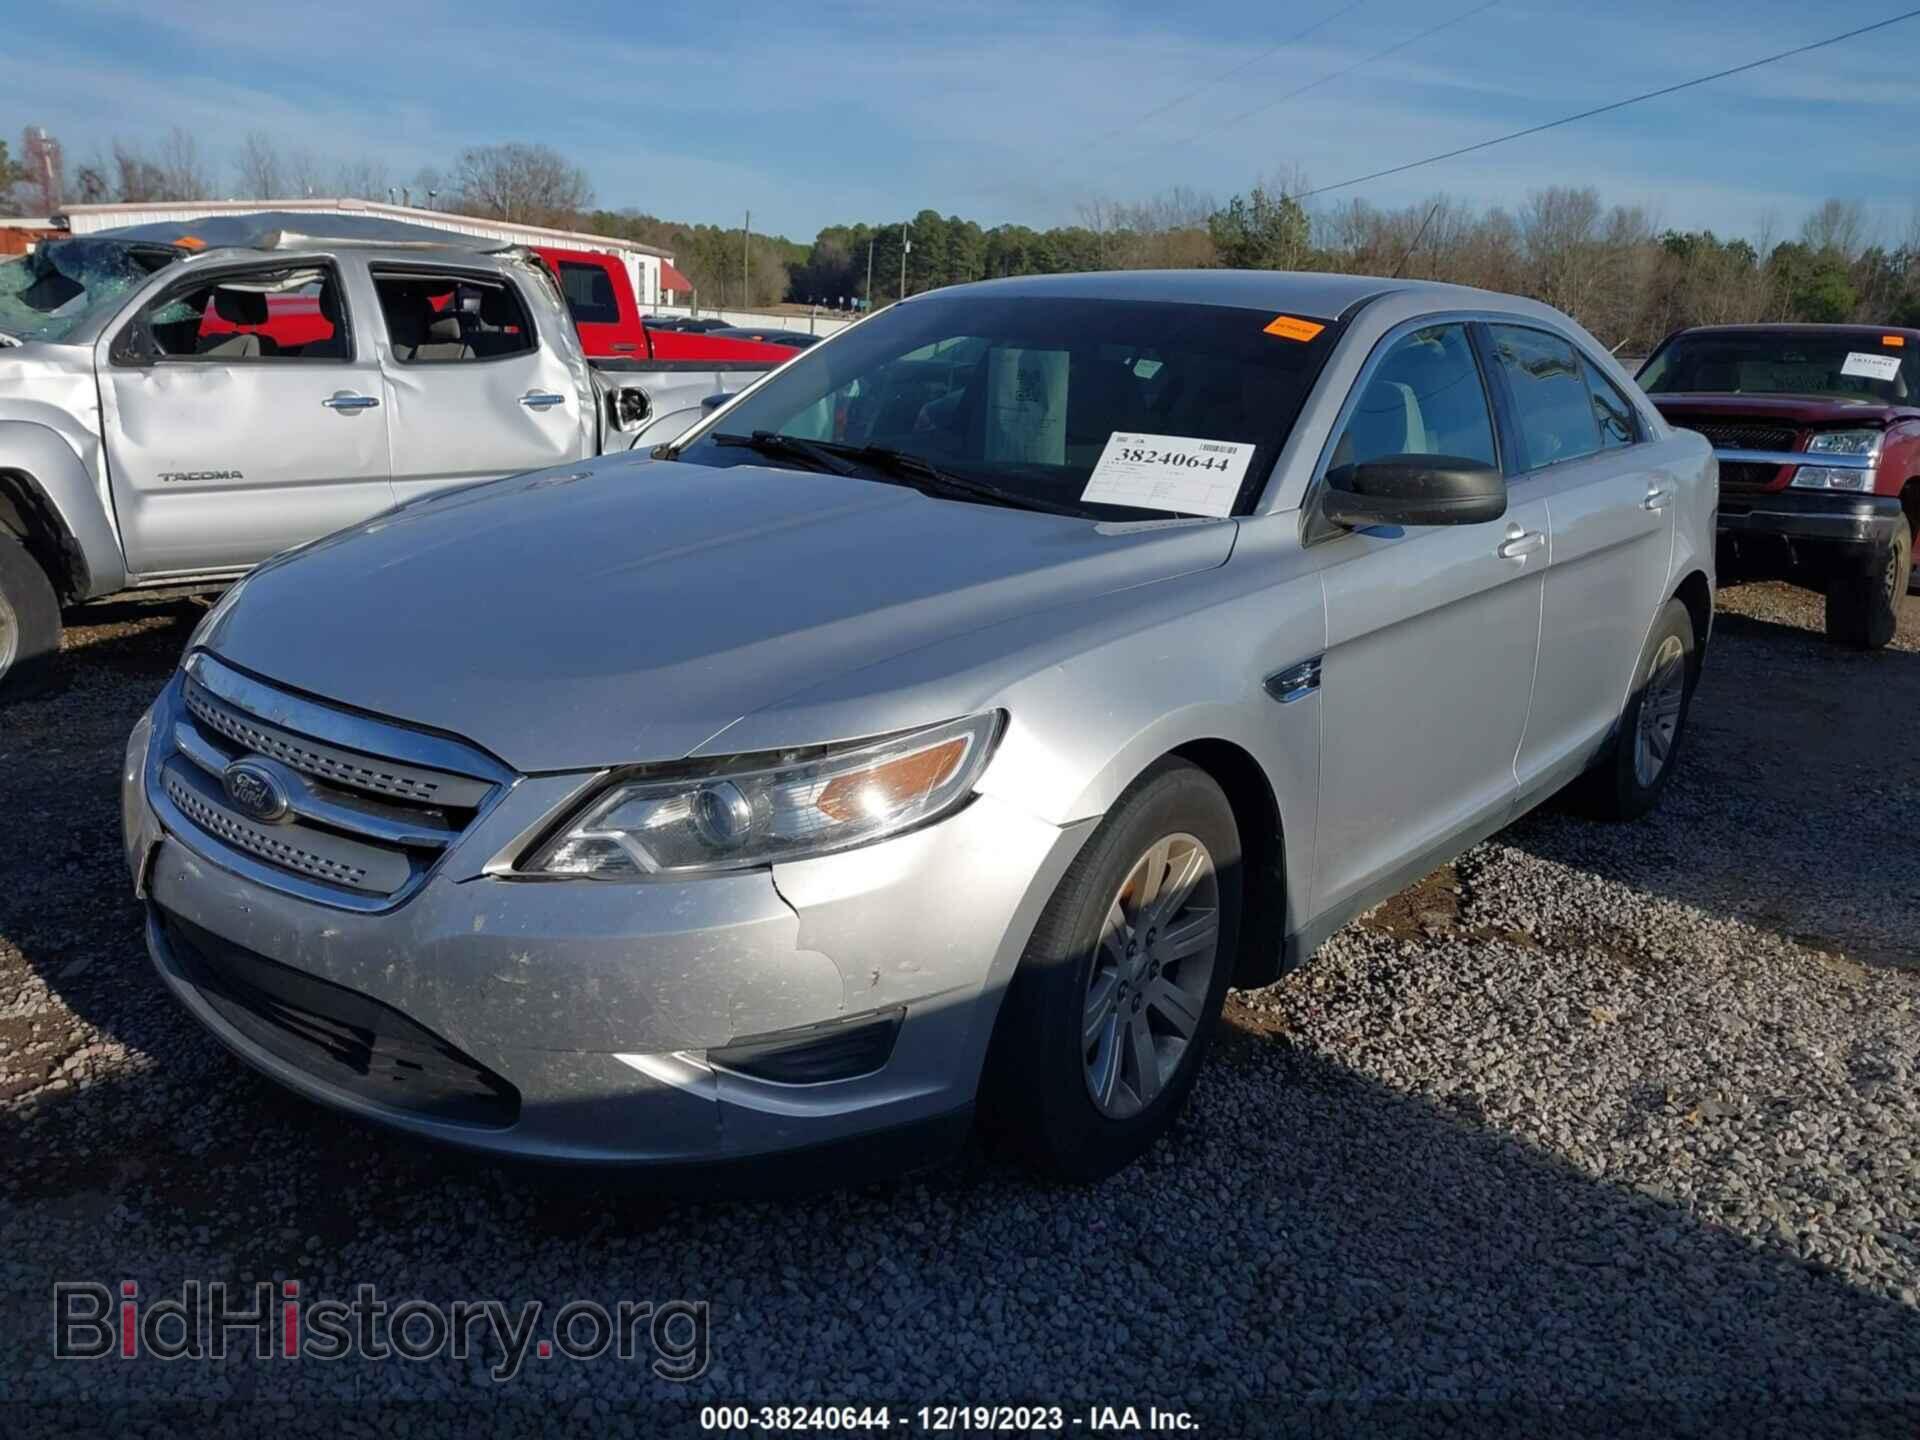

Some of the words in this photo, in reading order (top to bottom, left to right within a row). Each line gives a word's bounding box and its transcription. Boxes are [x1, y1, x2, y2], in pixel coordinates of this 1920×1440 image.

[1114, 447, 1230, 472] 38240644
[157, 470, 244, 482] TACOMA
[231, 773, 270, 808] Ford
